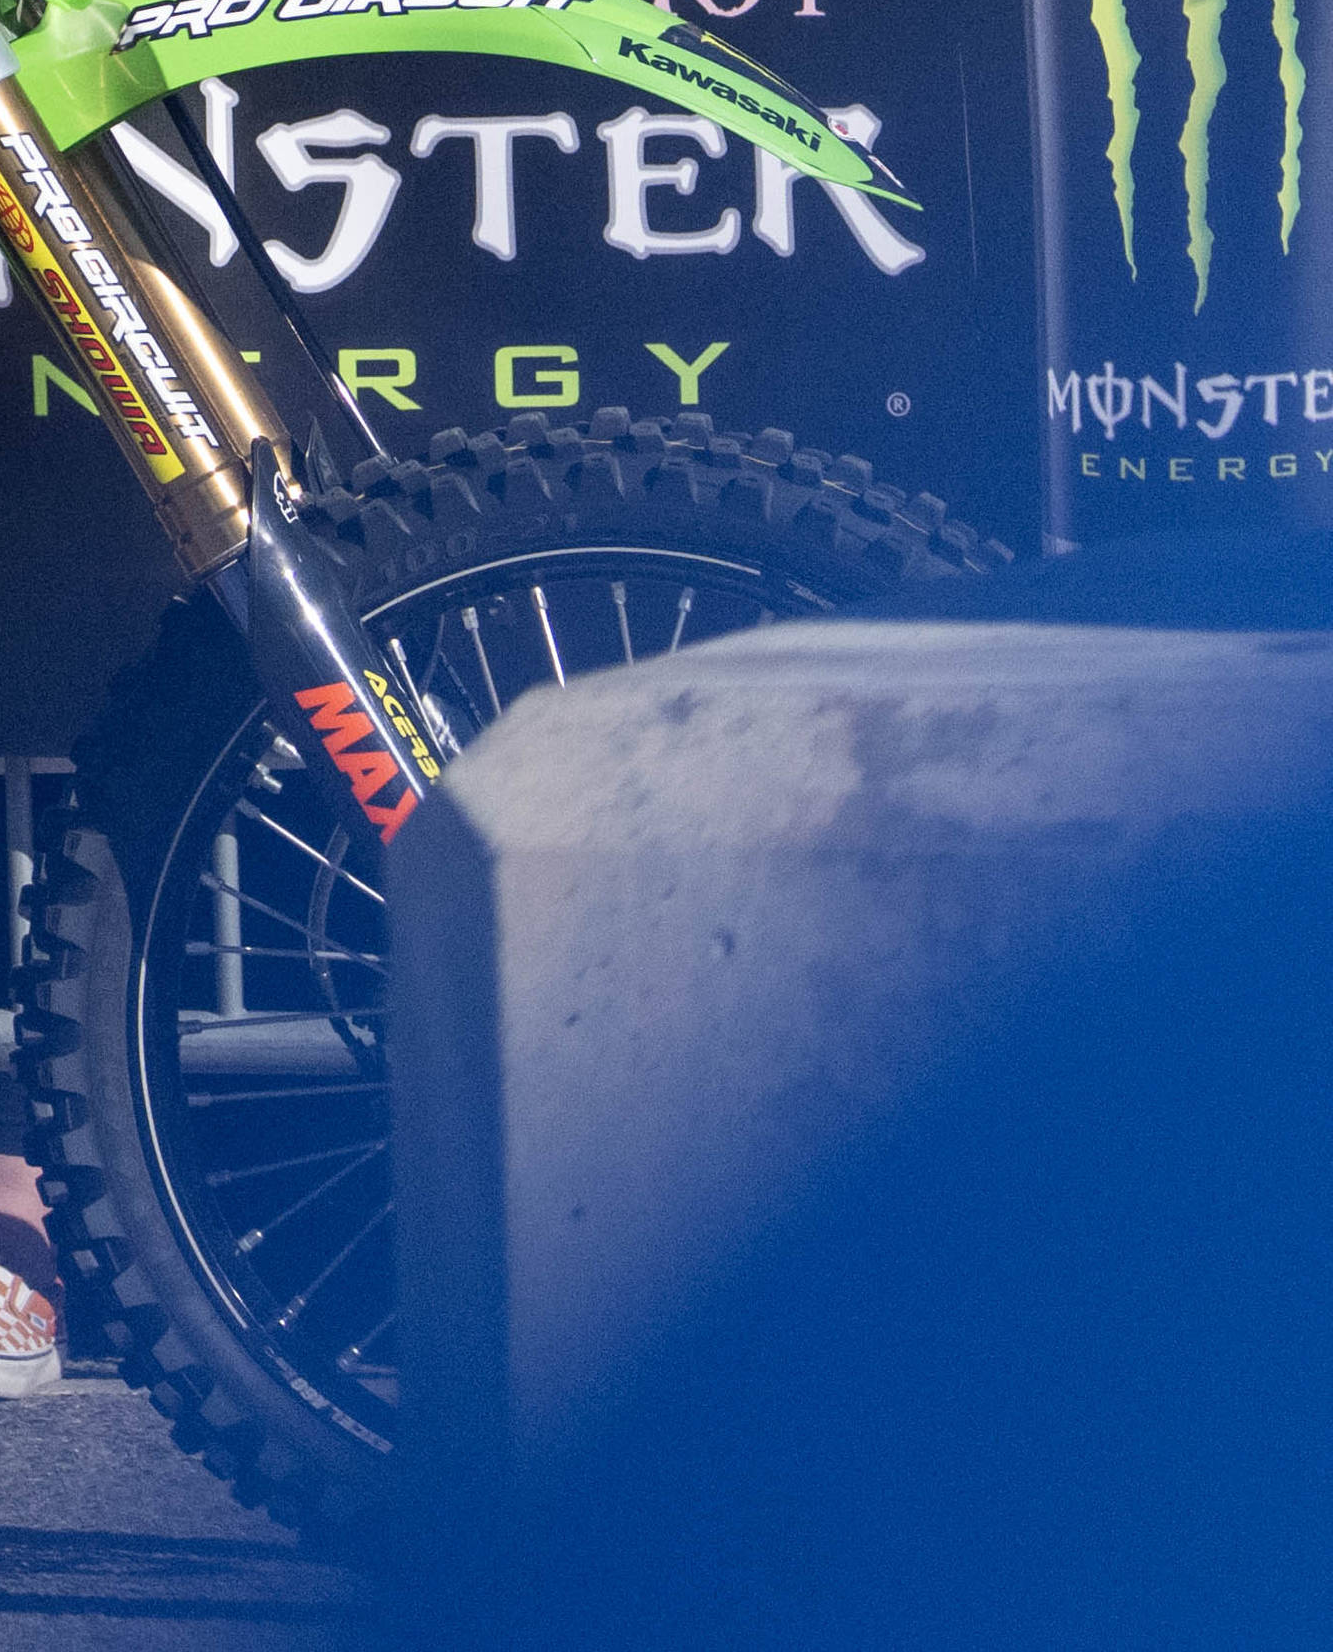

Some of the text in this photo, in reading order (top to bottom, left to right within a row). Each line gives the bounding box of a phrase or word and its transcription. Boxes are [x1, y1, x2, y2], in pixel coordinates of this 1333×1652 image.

[618, 36, 822, 154] Kawasaki
[43, 268, 167, 456] SHOWA
[71, 248, 219, 448] CIRCUIT
